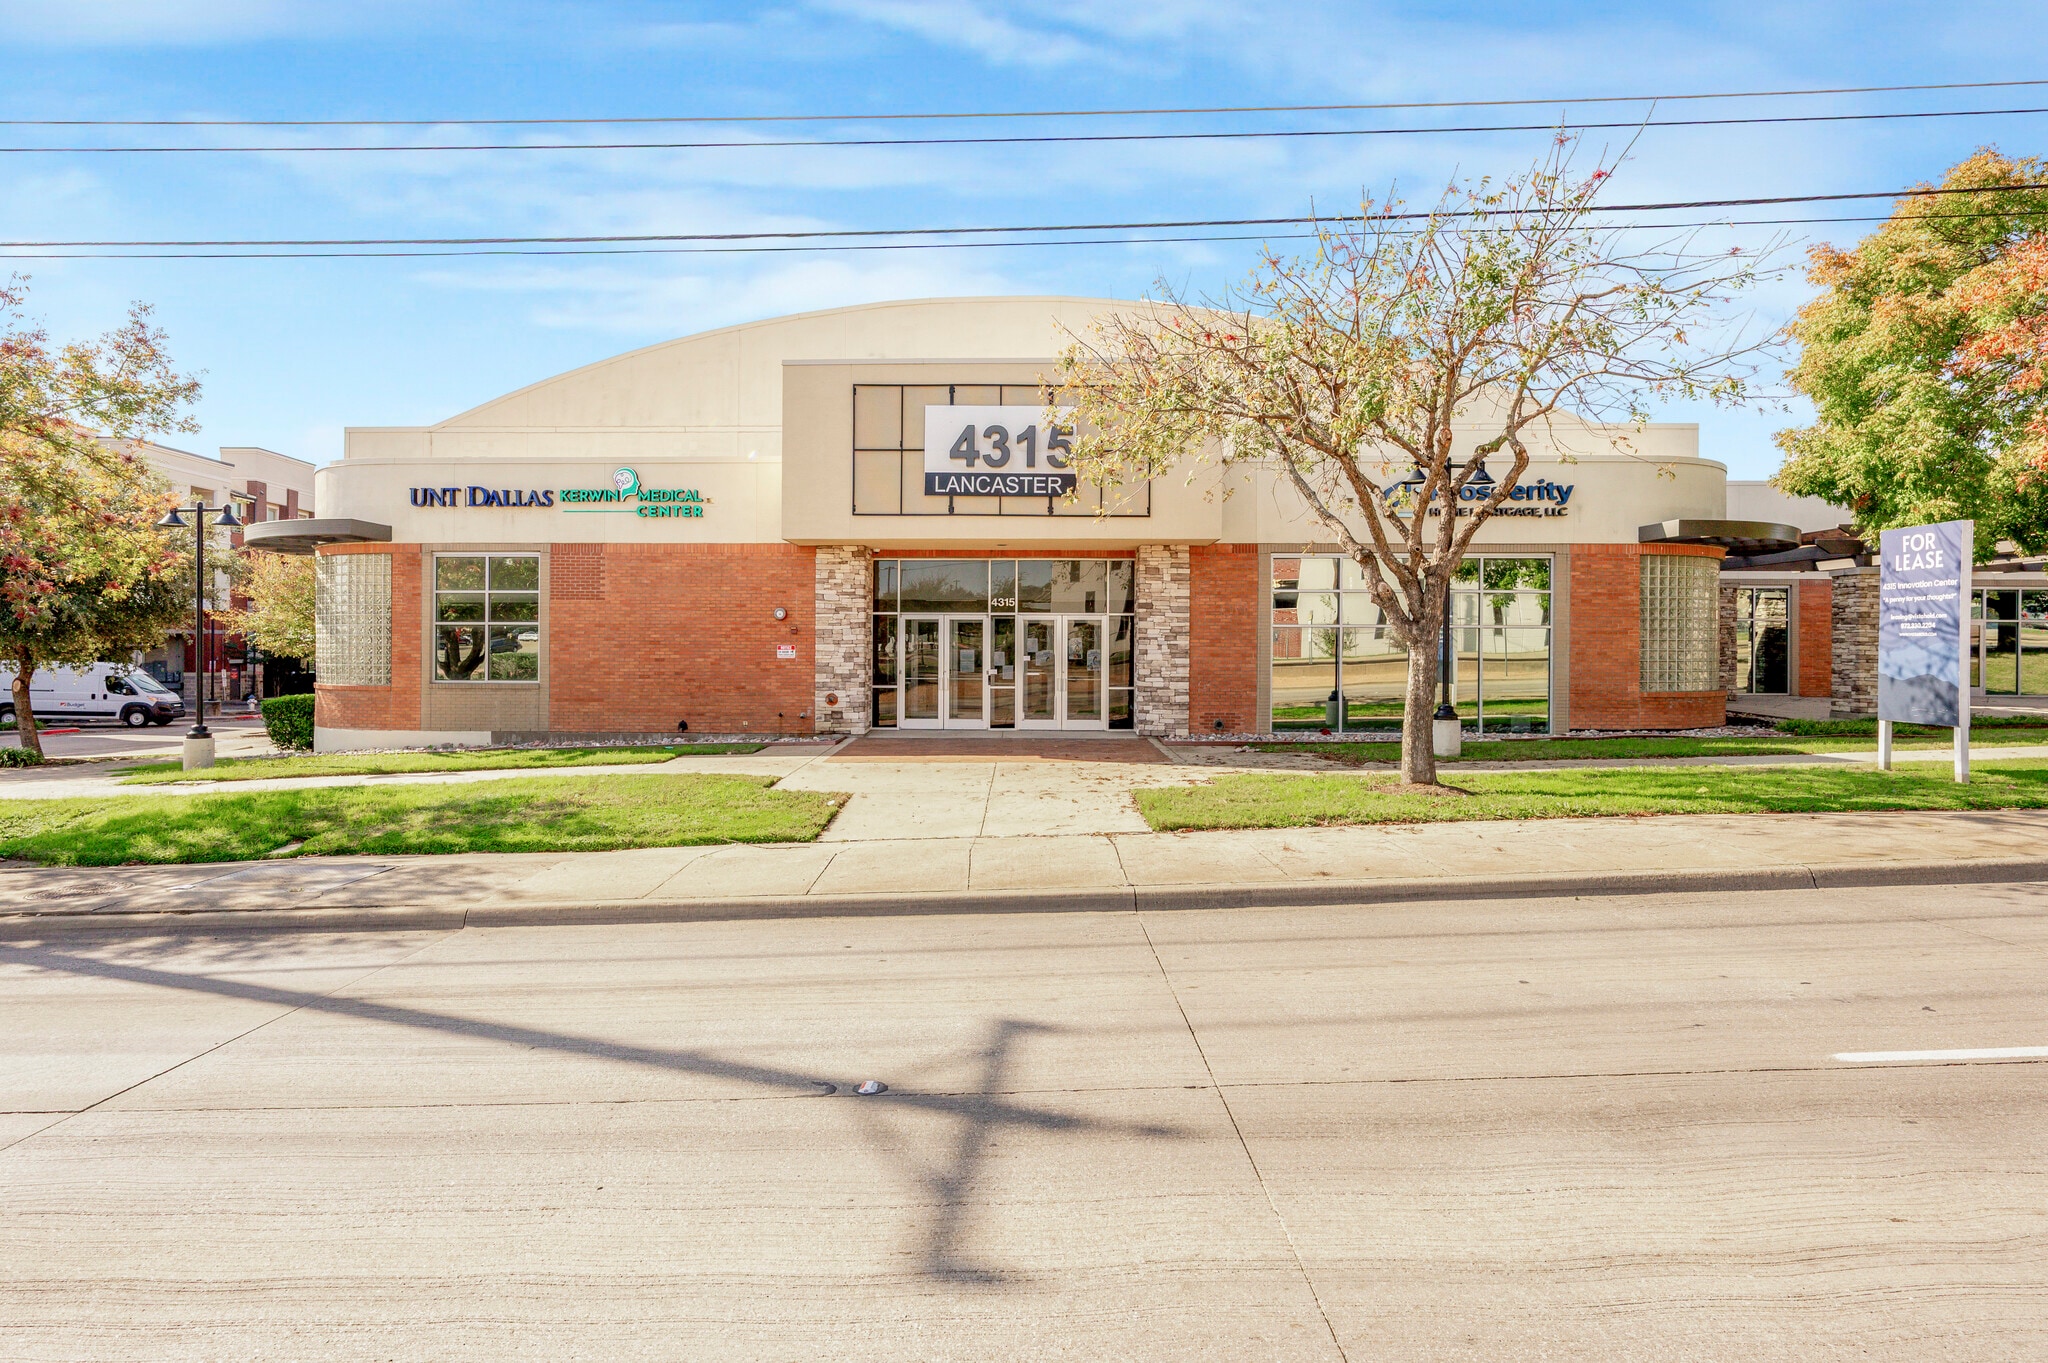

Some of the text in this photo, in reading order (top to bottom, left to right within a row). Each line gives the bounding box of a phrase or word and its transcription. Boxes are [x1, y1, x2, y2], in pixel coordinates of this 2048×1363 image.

[949, 424, 1074, 468] 4315
[935, 475, 1063, 494] LANCASTER
[1430, 478, 1574, 506] oserity
[409, 485, 554, 508] UNT DALLAS
[560, 489, 704, 503] KERWIN MEDICAL
[636, 505, 704, 518] CENTER
[1544, 507, 1569, 517] LLC
[1902, 532, 1936, 553] FOR
[1895, 550, 1944, 572] LEASE
[1882, 578, 1959, 591] 4315 Innovation Center
[991, 597, 1015, 607] 4315
[1889, 596, 1906, 605] penny
[1913, 595, 1926, 603] your
